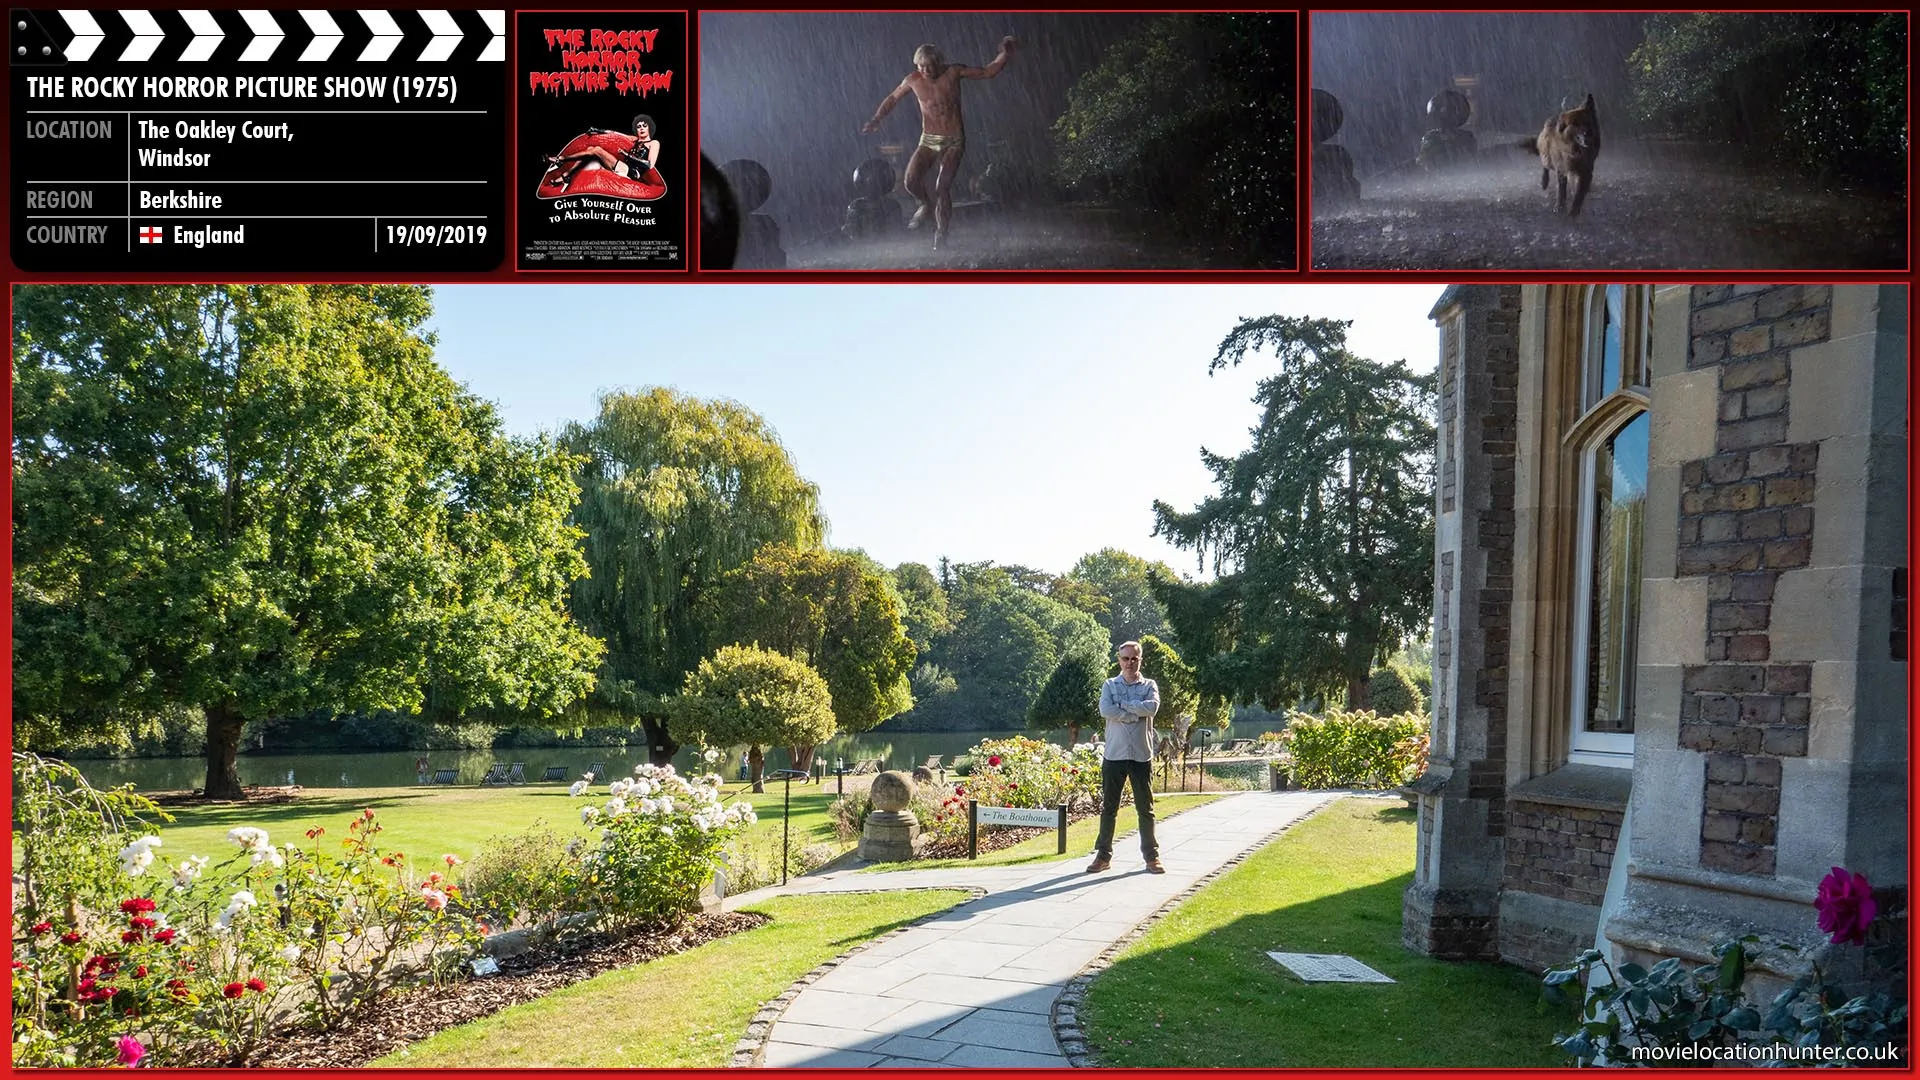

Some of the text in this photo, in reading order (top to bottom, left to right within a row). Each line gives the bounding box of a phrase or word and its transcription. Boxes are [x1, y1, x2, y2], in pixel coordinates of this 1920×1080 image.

[543, 29, 659, 52] THE ROCKY
[562, 50, 641, 72] HORROR
[530, 70, 673, 97] PICTURE SHOW
[992, 811, 1053, 823] The Boathouse
